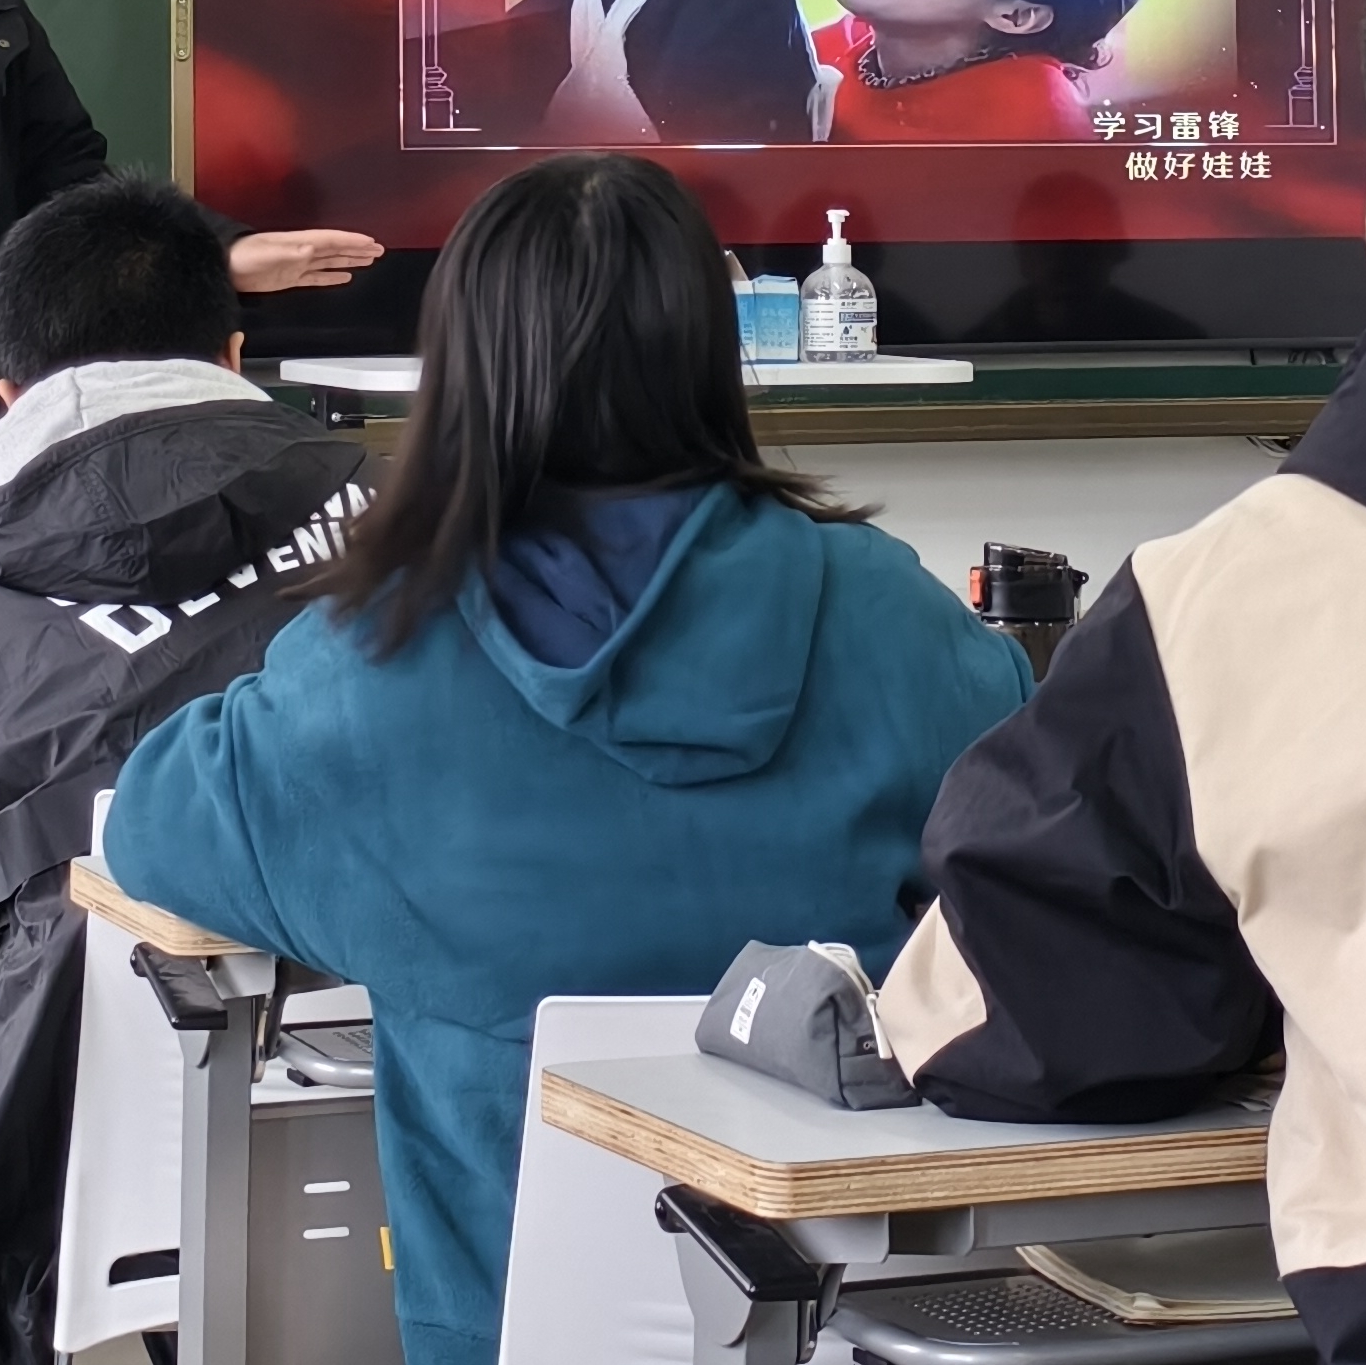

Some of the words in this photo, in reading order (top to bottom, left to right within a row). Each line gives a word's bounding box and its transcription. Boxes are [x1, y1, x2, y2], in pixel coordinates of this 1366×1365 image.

[1093, 111, 1240, 141] 学习雷锋
[1125, 150, 1272, 181] 做好娃娃
